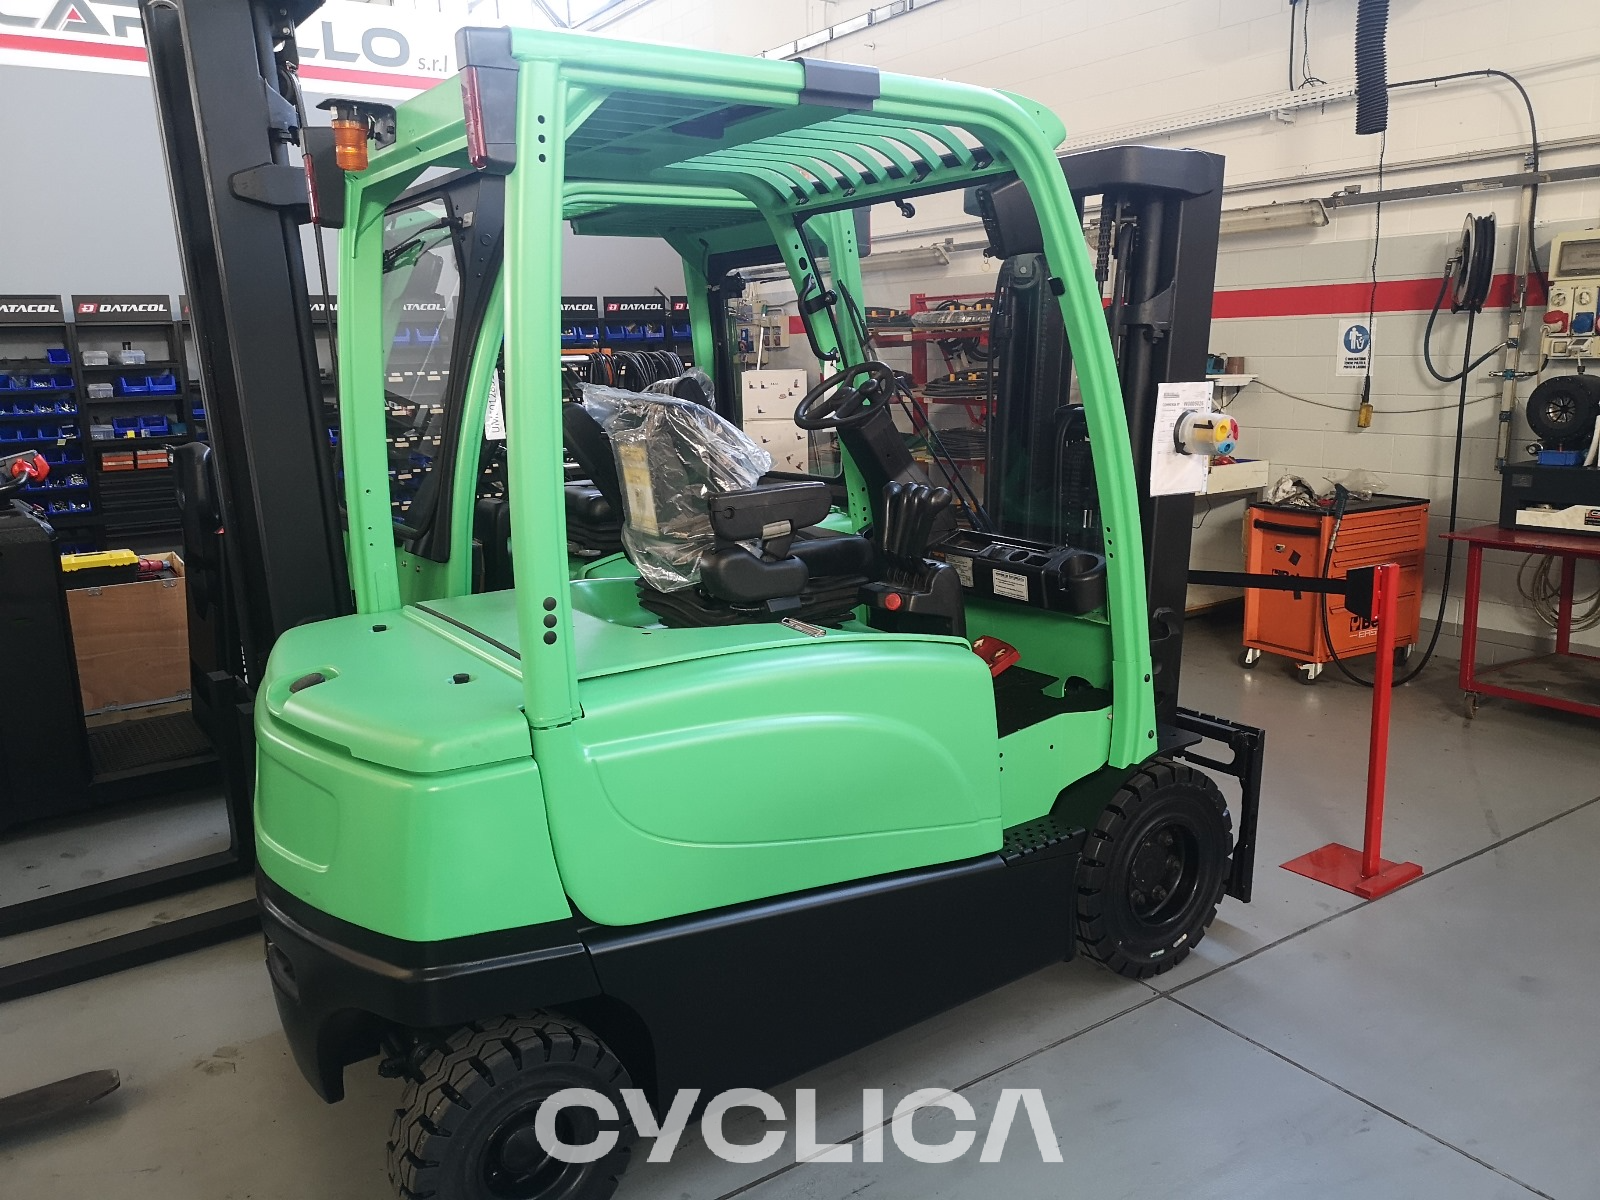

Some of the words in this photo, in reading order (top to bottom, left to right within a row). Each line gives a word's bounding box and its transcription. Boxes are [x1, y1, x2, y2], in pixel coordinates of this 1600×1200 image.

[0, 304, 59, 313] ATACOL
[99, 304, 168, 312] DATACOL
[619, 303, 664, 311] DATACOL
